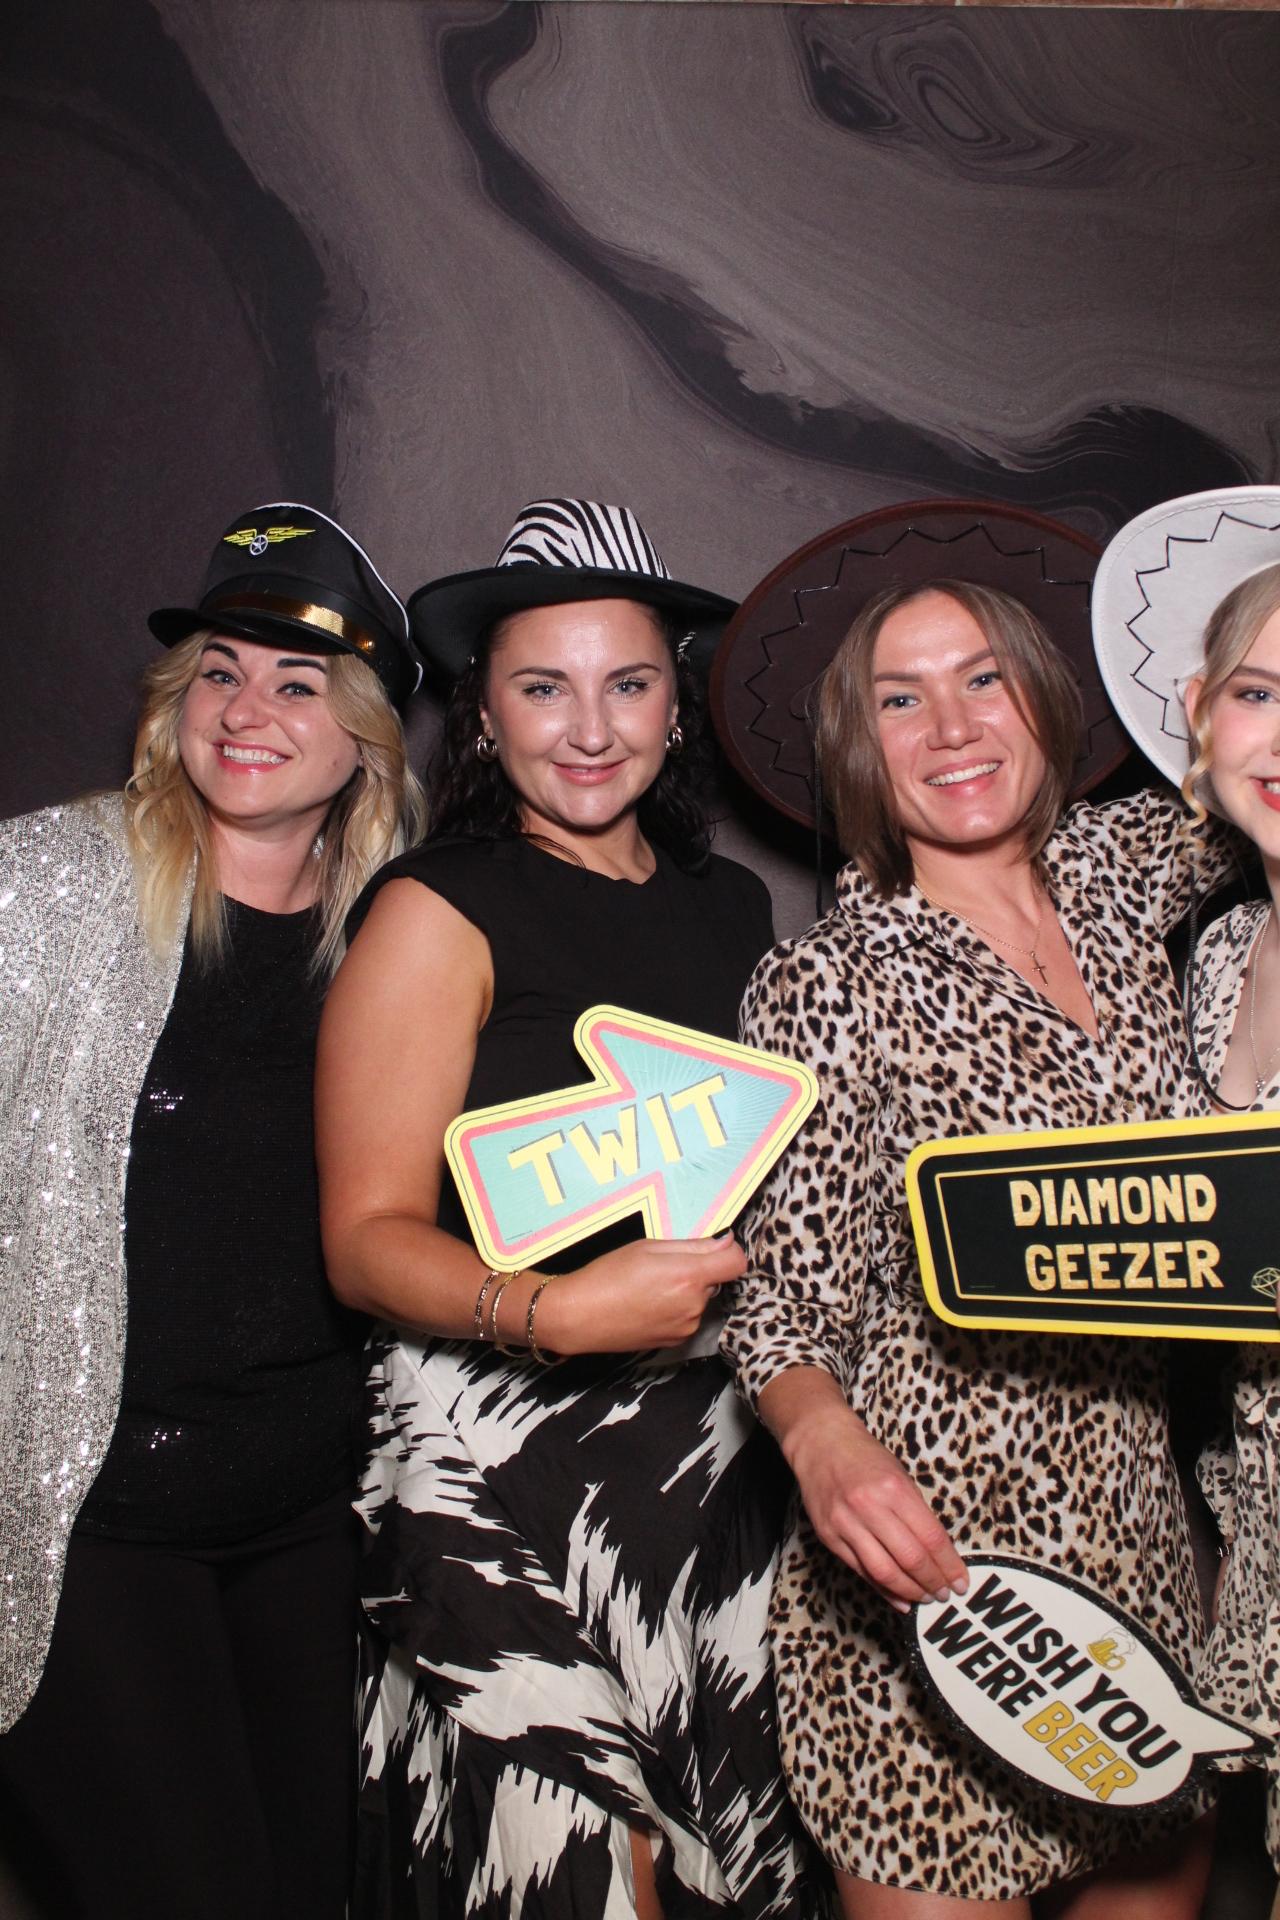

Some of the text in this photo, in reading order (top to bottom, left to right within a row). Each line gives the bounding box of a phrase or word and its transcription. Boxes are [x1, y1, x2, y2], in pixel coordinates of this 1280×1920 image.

[507, 1073, 728, 1206] TWIT
[1009, 1174, 1217, 1226] DIAMOND
[1025, 1240, 1224, 1291] GEEZER
[923, 1605, 1138, 1802] WERE BEER
[965, 1573, 1182, 1769] WISH YOU
